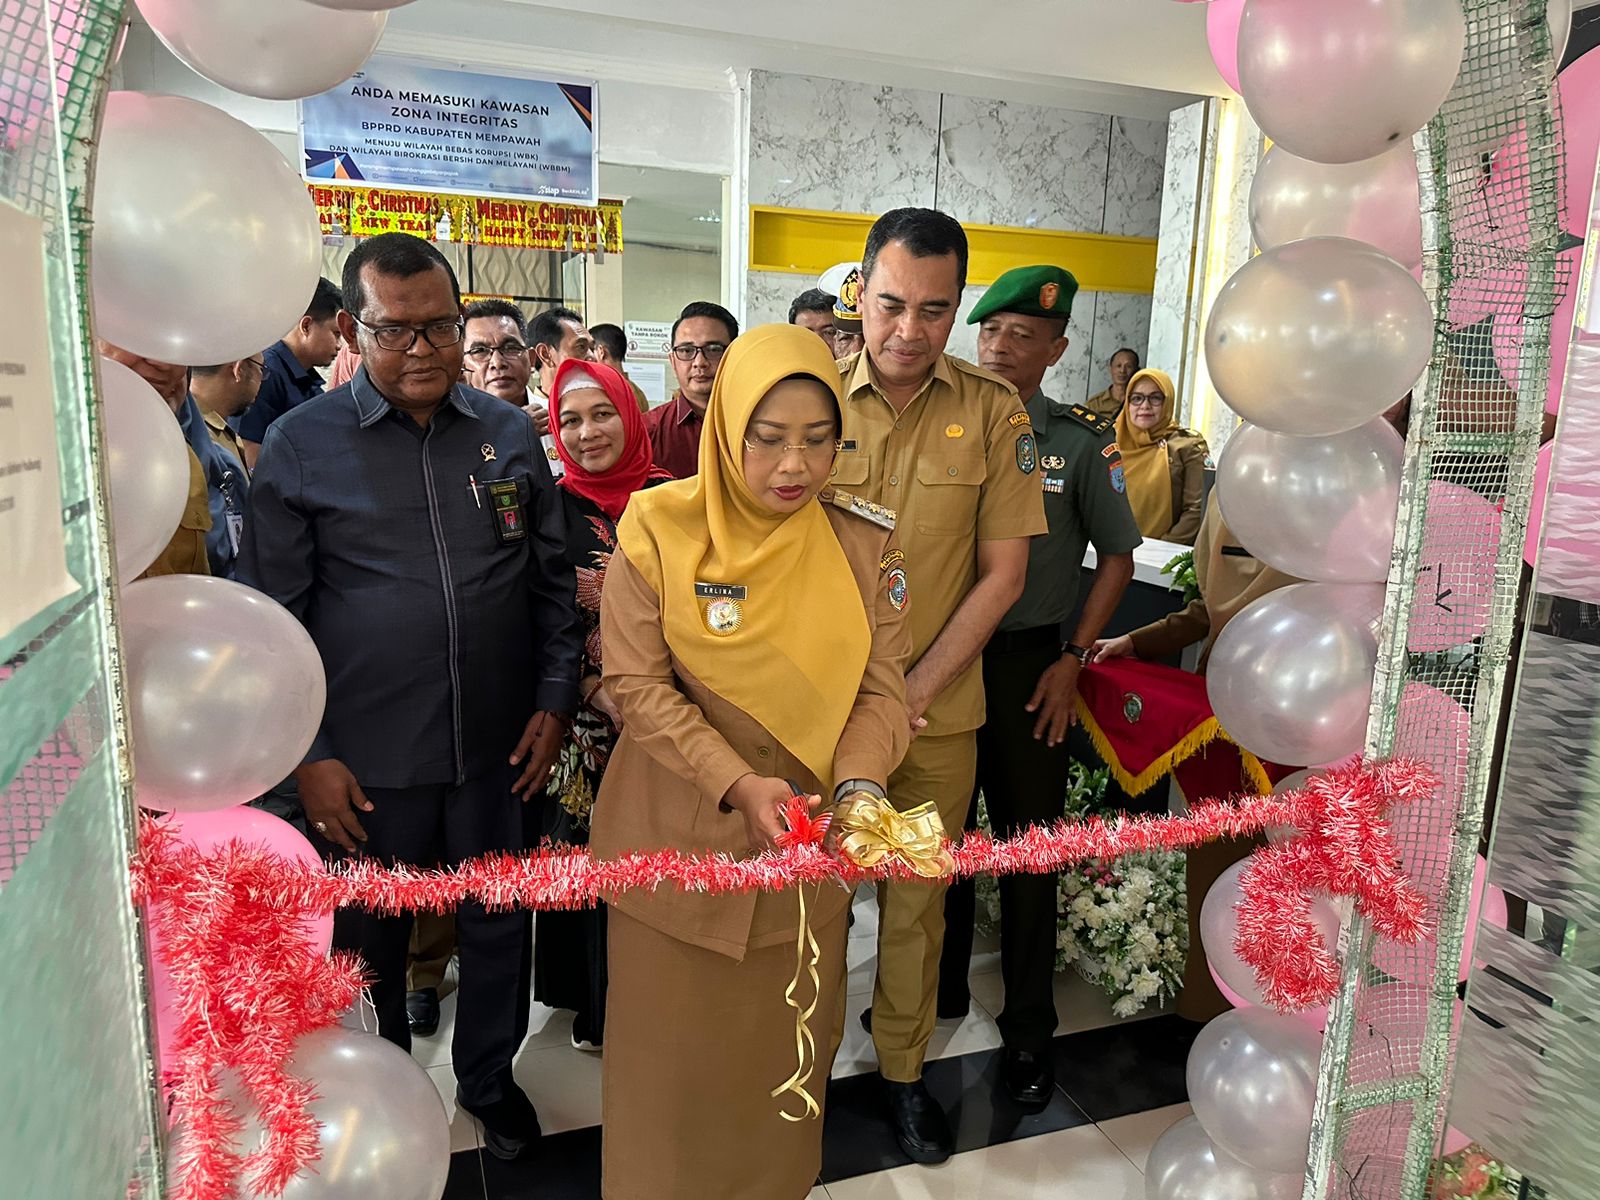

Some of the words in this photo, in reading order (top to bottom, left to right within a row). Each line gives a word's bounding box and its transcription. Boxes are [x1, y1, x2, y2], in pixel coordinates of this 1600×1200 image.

[351, 86, 394, 100] ANDA
[399, 91, 475, 108] MEMASUKI
[480, 99, 549, 116] KAWASAN
[391, 106, 432, 120] ZONA
[437, 111, 518, 128] INTEGRITAS
[362, 121, 401, 133] BPPRD
[405, 126, 472, 140] KABUPATEN
[475, 133, 541, 146] MEMPAWAH
[329, 144, 348, 152] DAN
[351, 147, 391, 156] WILAYAH
[394, 151, 441, 161] BIROKRASI
[443, 155, 473, 164] BERSIH
[496, 160, 537, 170] MELAYANI
[539, 163, 571, 173] (WBBM)
[365, 138, 401, 147] MENUJU
[404, 142, 442, 151] WILAYAH
[445, 146, 473, 154] BEBAS
[475, 149, 511, 158] KORUPSI
[513, 152, 539, 161] (WBK)
[368, 189, 440, 215] CHRISTMAS
[476, 198, 528, 222] MERRY
[538, 202, 605, 227] CHRISTMAS
[361, 217, 391, 229] NEW
[484, 225, 526, 239] HAPPY
[532, 229, 560, 242] NEW
[704, 587, 732, 595] ERLINA
